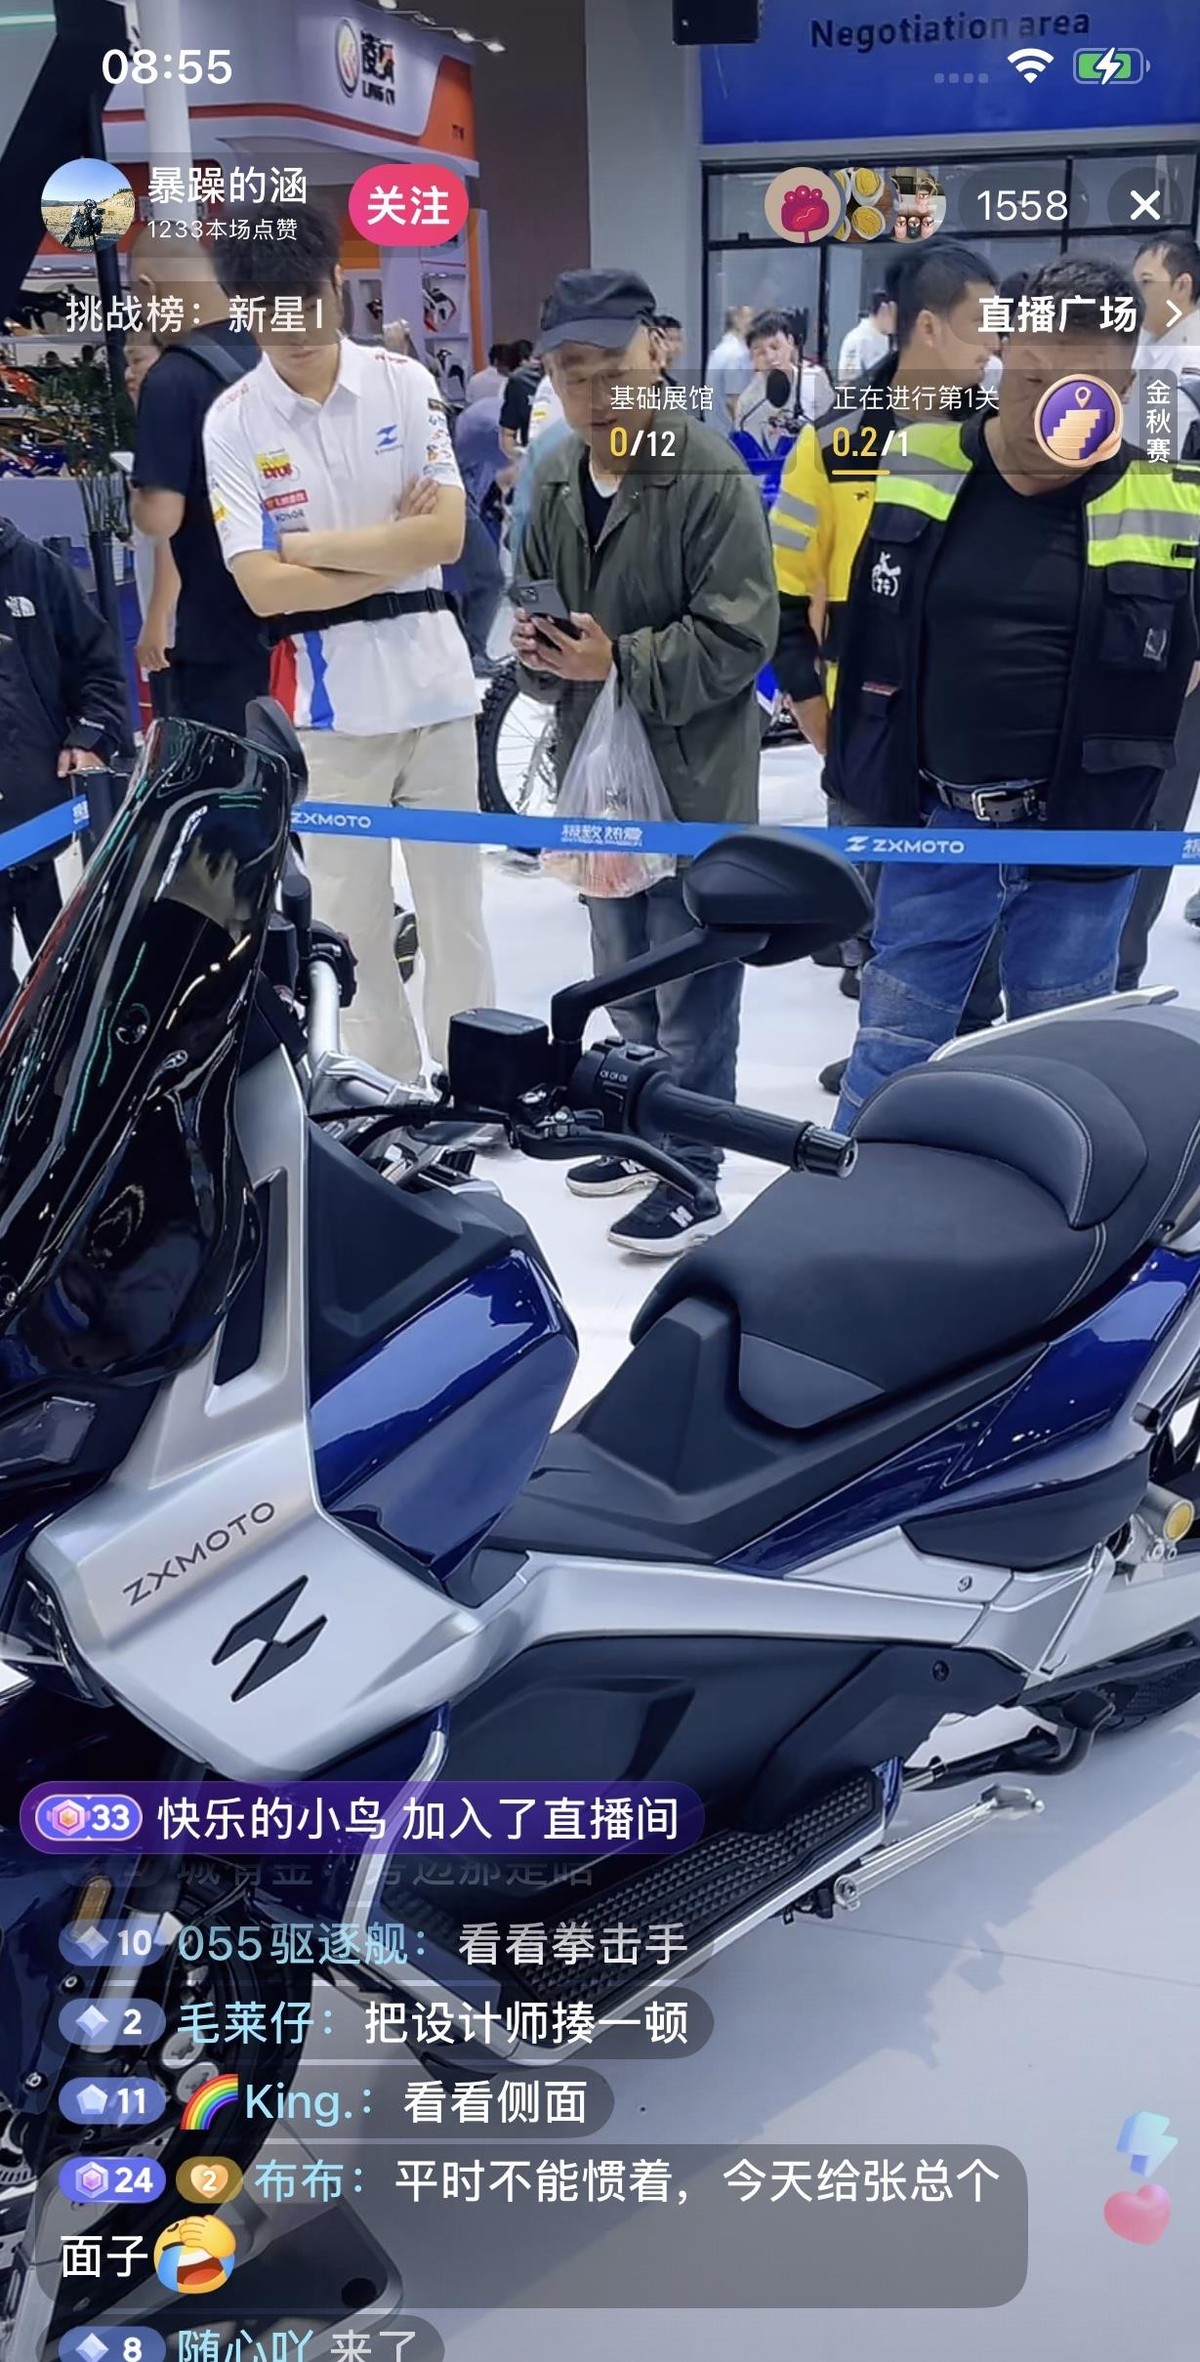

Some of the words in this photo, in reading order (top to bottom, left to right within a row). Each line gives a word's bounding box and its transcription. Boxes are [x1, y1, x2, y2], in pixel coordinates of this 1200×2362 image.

[811, 12, 1006, 53] Negotiation
[1019, 11, 1091, 37] area
[872, 839, 965, 854] ZXMOTO
[122, 1501, 276, 1606] ZXMOTO
